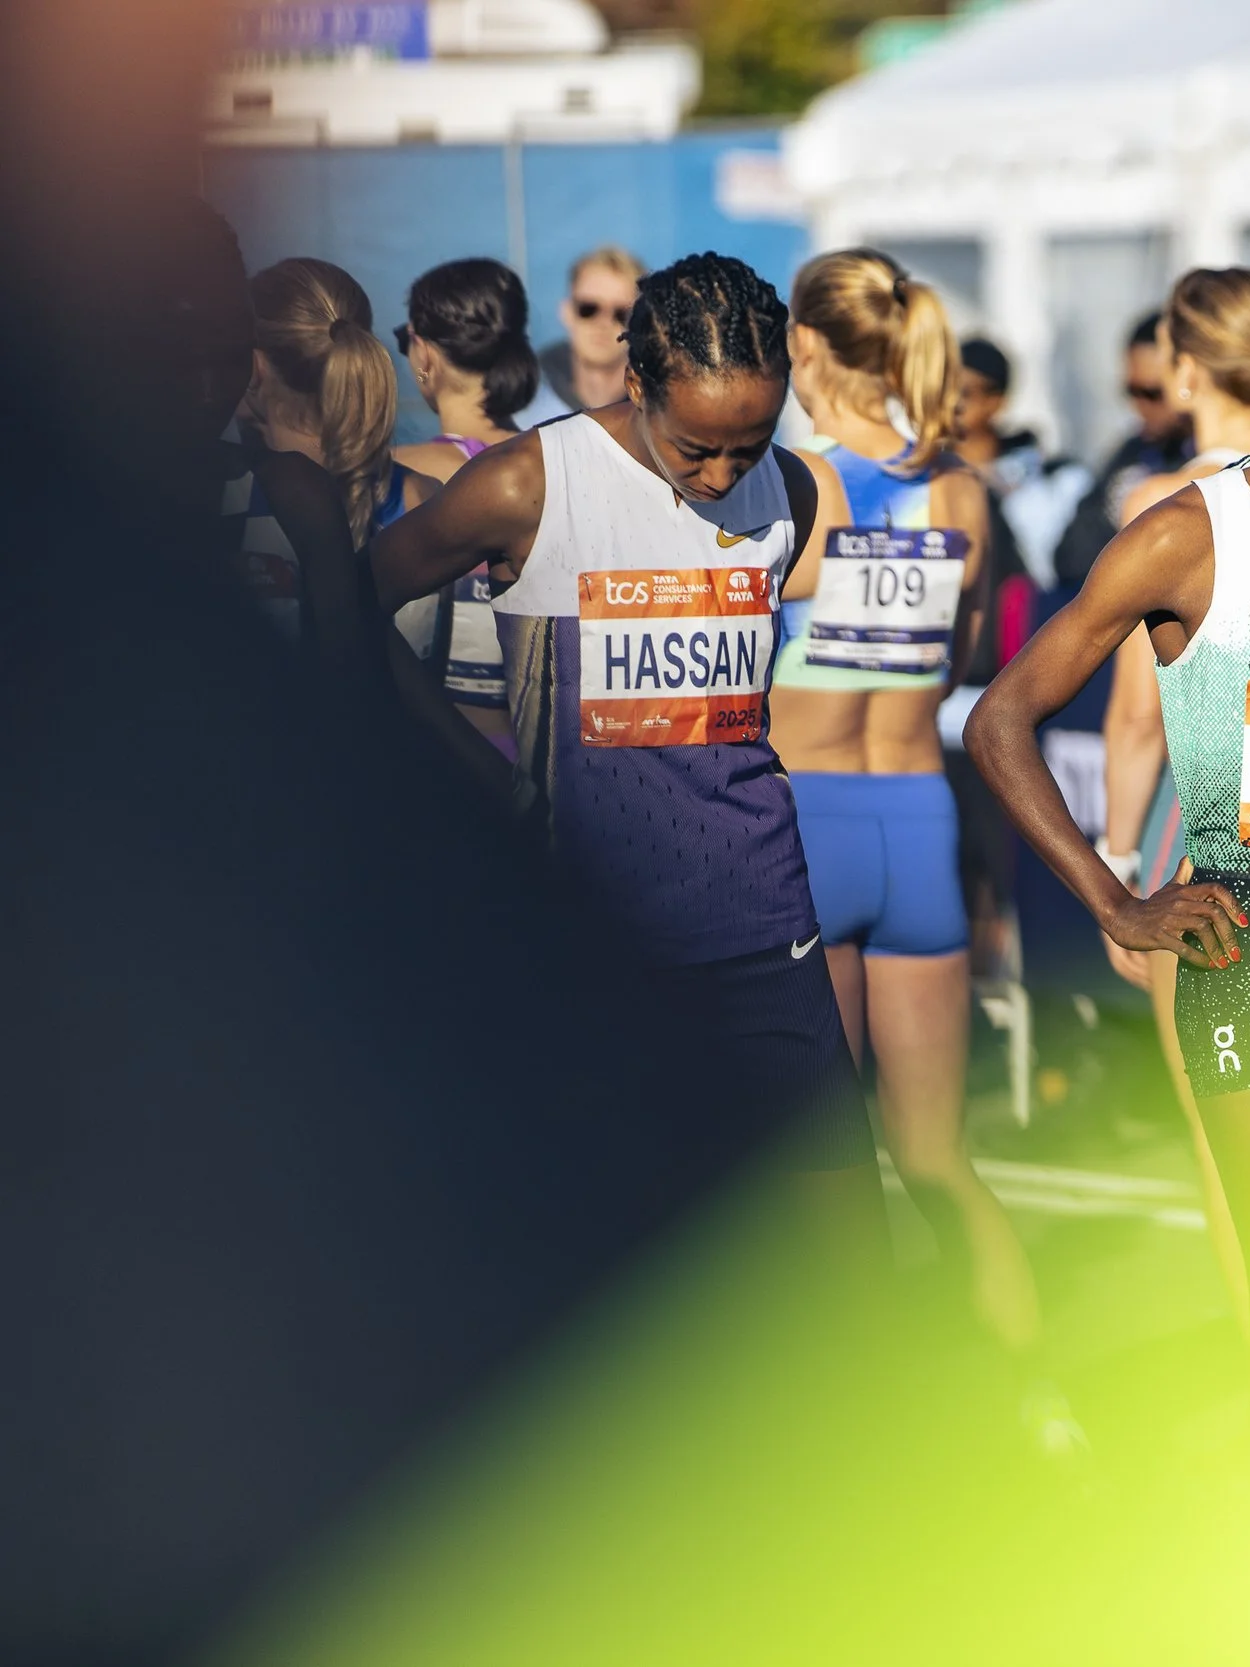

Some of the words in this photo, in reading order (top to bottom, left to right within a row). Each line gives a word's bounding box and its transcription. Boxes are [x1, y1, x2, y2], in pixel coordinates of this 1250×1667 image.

[652, 575, 679, 584] TATA
[859, 564, 926, 607] 109
[605, 576, 649, 605] tcs
[653, 583, 712, 594] CONSULTANCY
[653, 594, 693, 604] SERVICES
[727, 591, 754, 602] TATA
[605, 630, 756, 690] HASSAN
[715, 709, 757, 728] 2025
